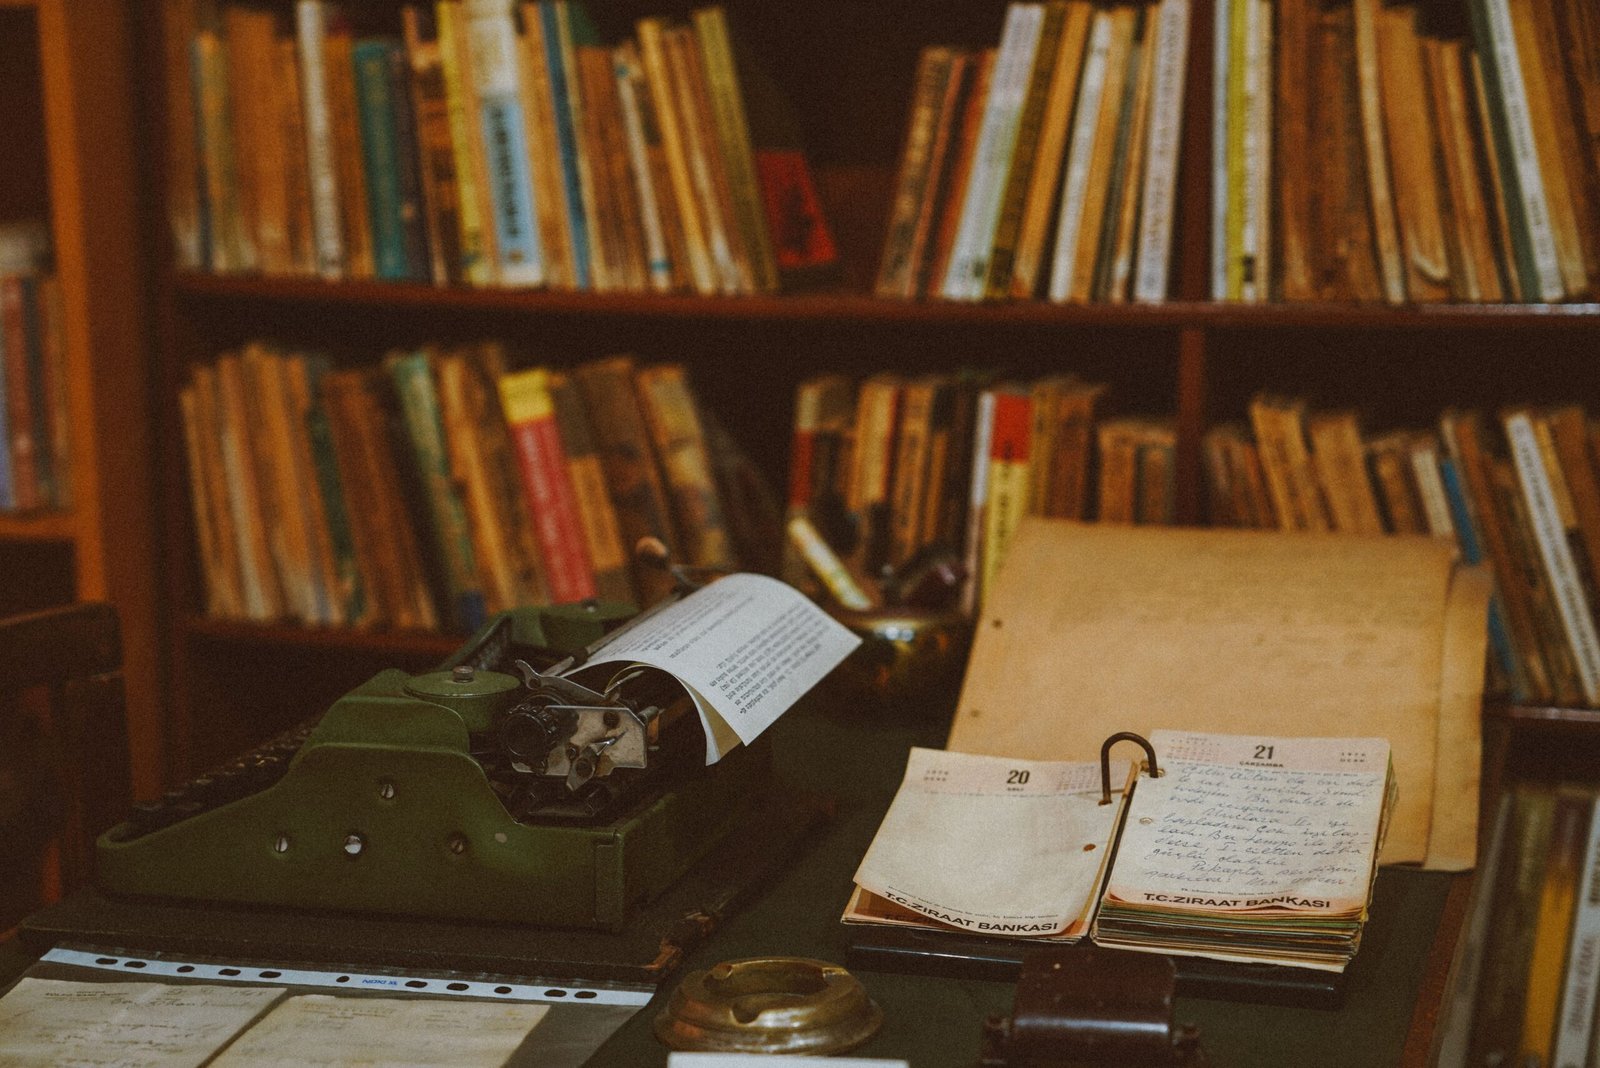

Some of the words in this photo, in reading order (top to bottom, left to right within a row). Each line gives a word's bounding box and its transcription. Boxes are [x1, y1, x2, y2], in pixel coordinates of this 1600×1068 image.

[1253, 744, 1275, 760] 21
[1006, 769, 1031, 785] 20
[1246, 896, 1330, 908] BANKASI
[978, 923, 1058, 932] BANKASI
